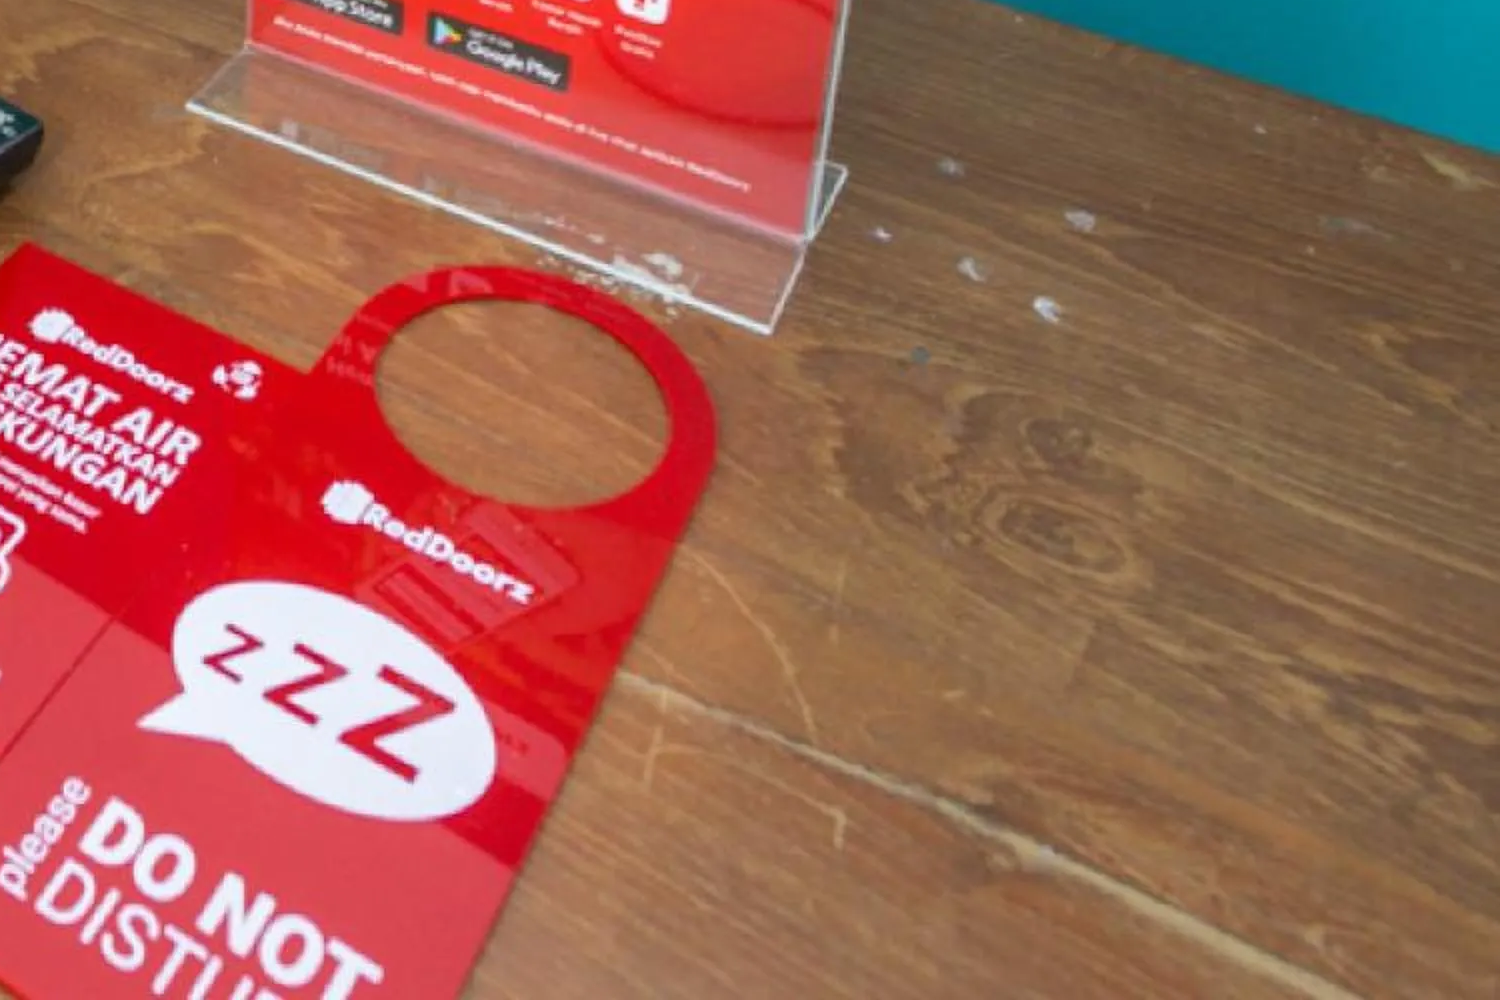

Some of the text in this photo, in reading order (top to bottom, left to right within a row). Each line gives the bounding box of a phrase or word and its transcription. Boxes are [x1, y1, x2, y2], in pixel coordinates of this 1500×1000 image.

[60, 325, 195, 404] RedDoorz
[0, 382, 180, 488] SELAMATKAN
[111, 407, 202, 465] AIR
[362, 503, 535, 604] RedDoorz
[78, 795, 384, 1000] DO NOT
